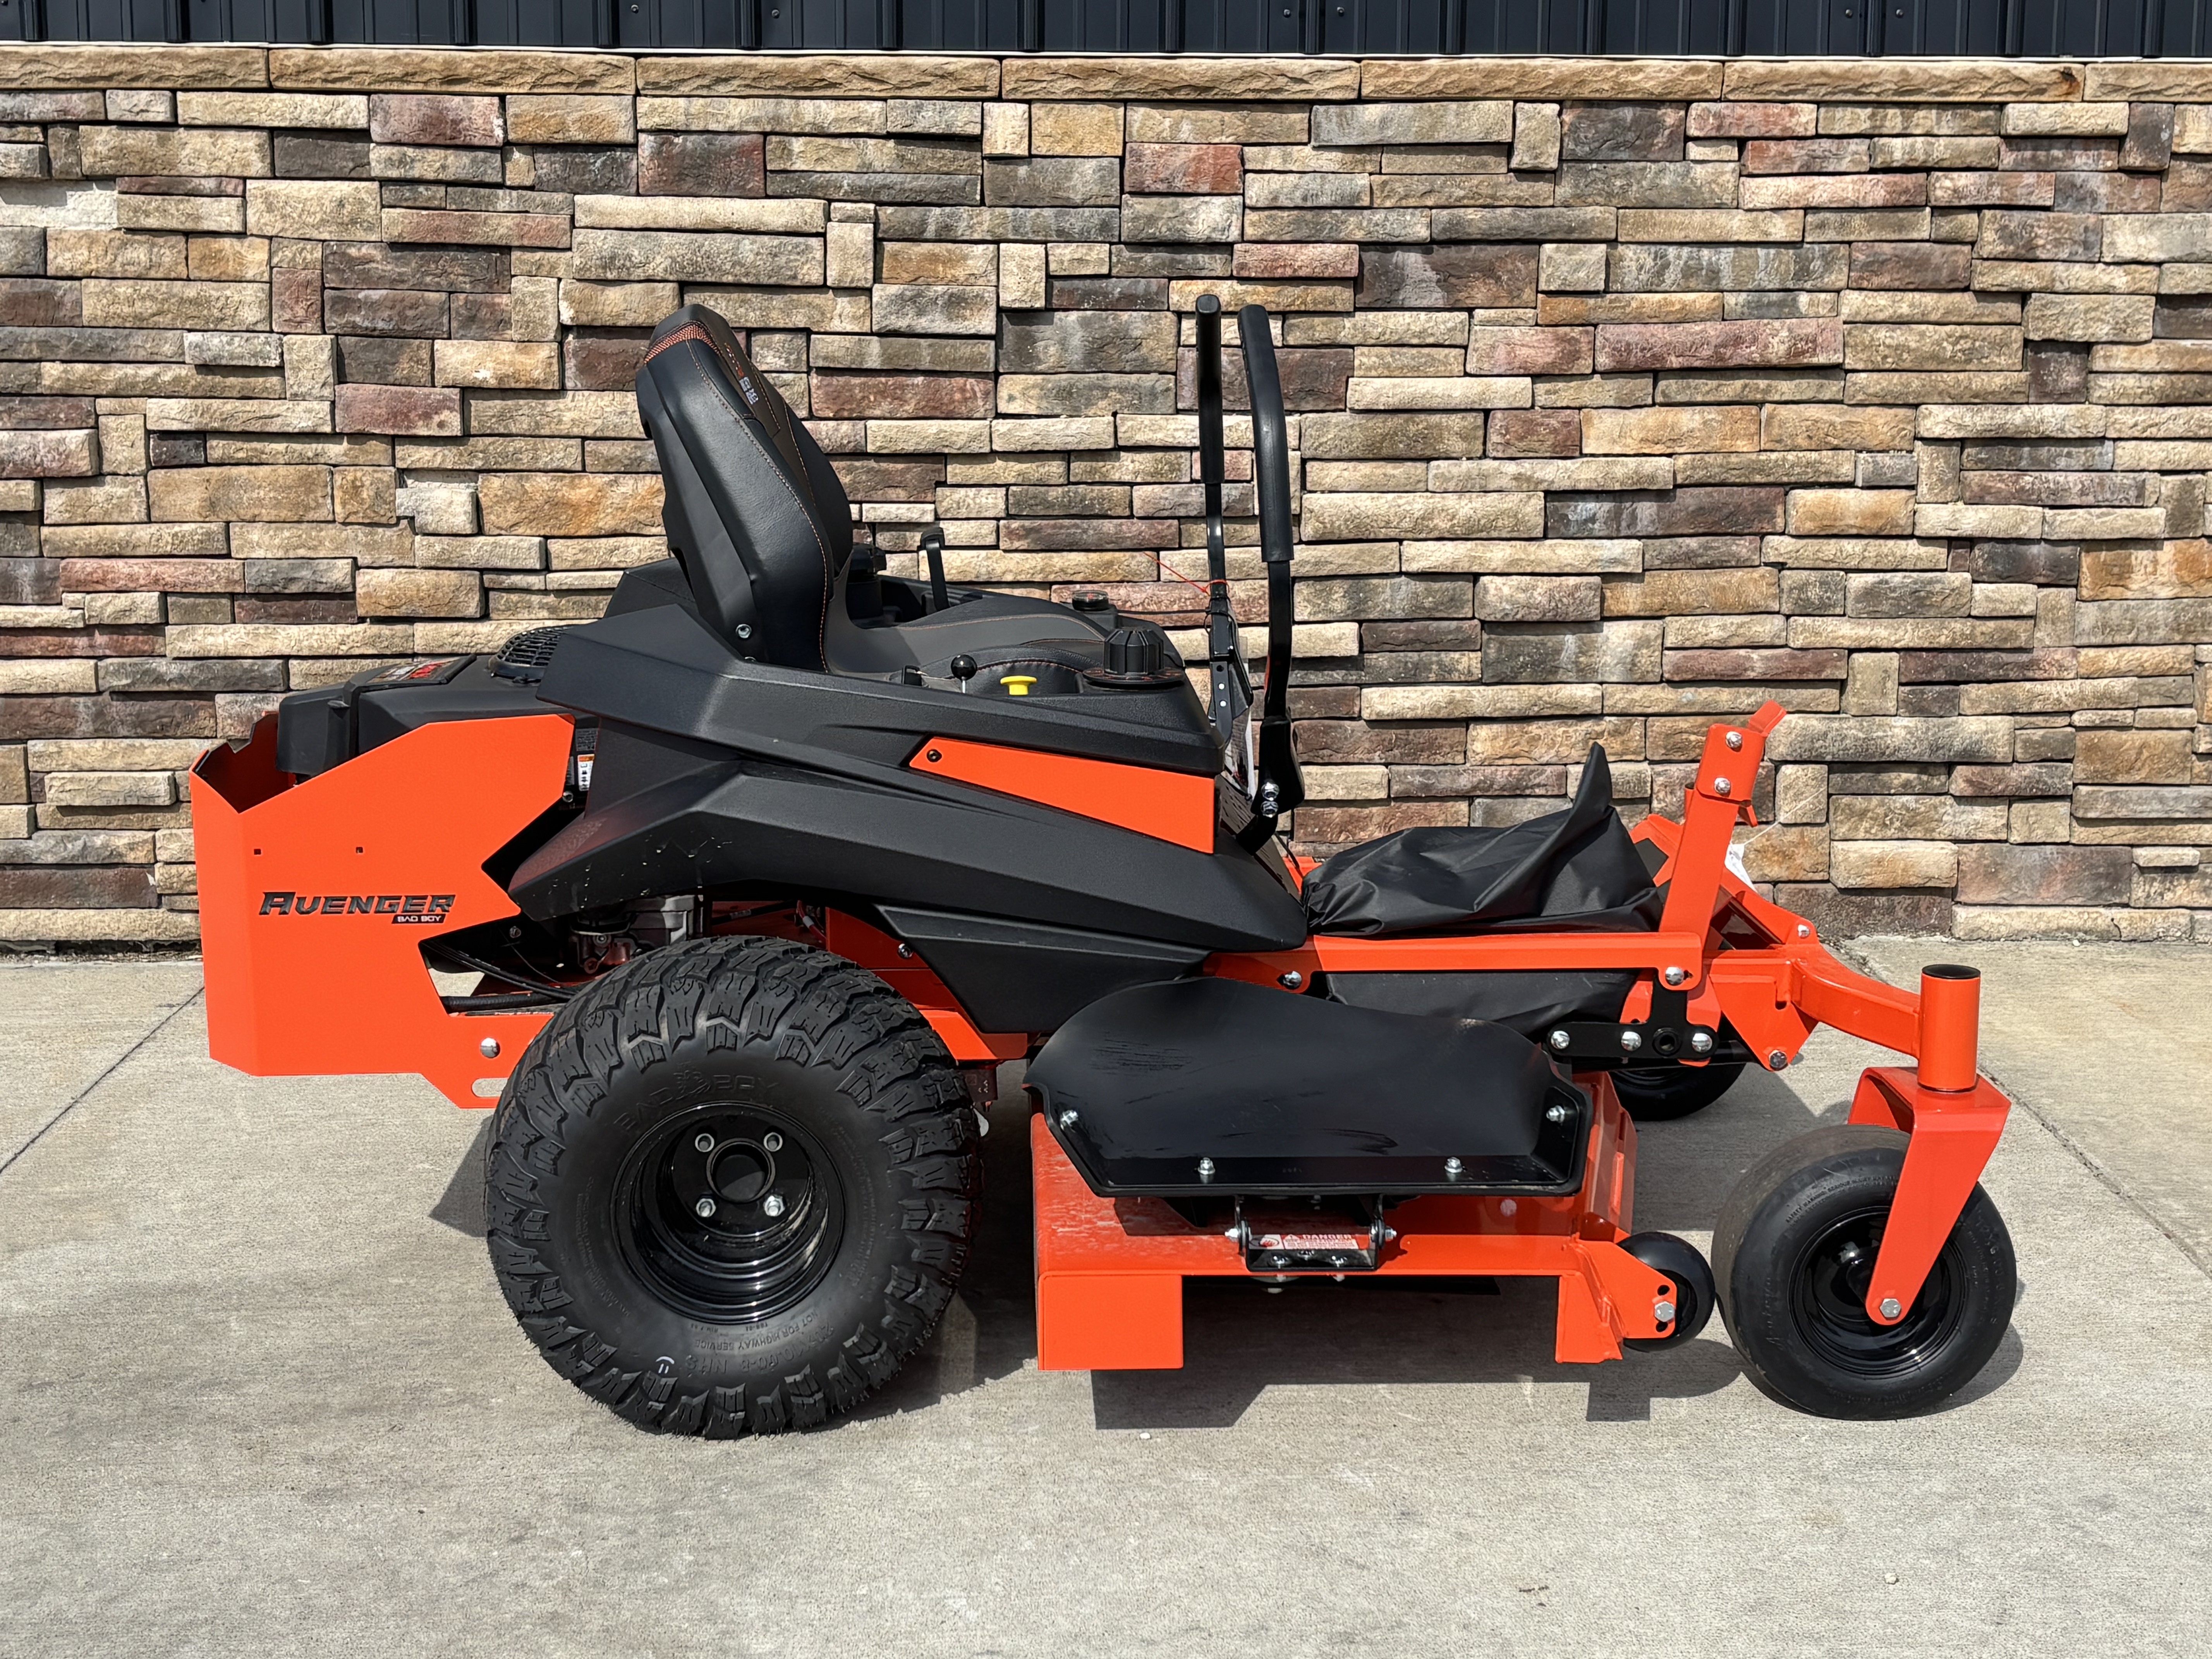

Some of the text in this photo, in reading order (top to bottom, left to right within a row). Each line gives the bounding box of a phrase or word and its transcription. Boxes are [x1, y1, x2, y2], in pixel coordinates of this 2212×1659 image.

[259, 891, 456, 915] AVENGER
[802, 1311, 819, 1328] NOT
[783, 1323, 800, 1338] FOR
[696, 1339, 734, 1351] SERVICE
[737, 1331, 781, 1350] HIGHWAY
